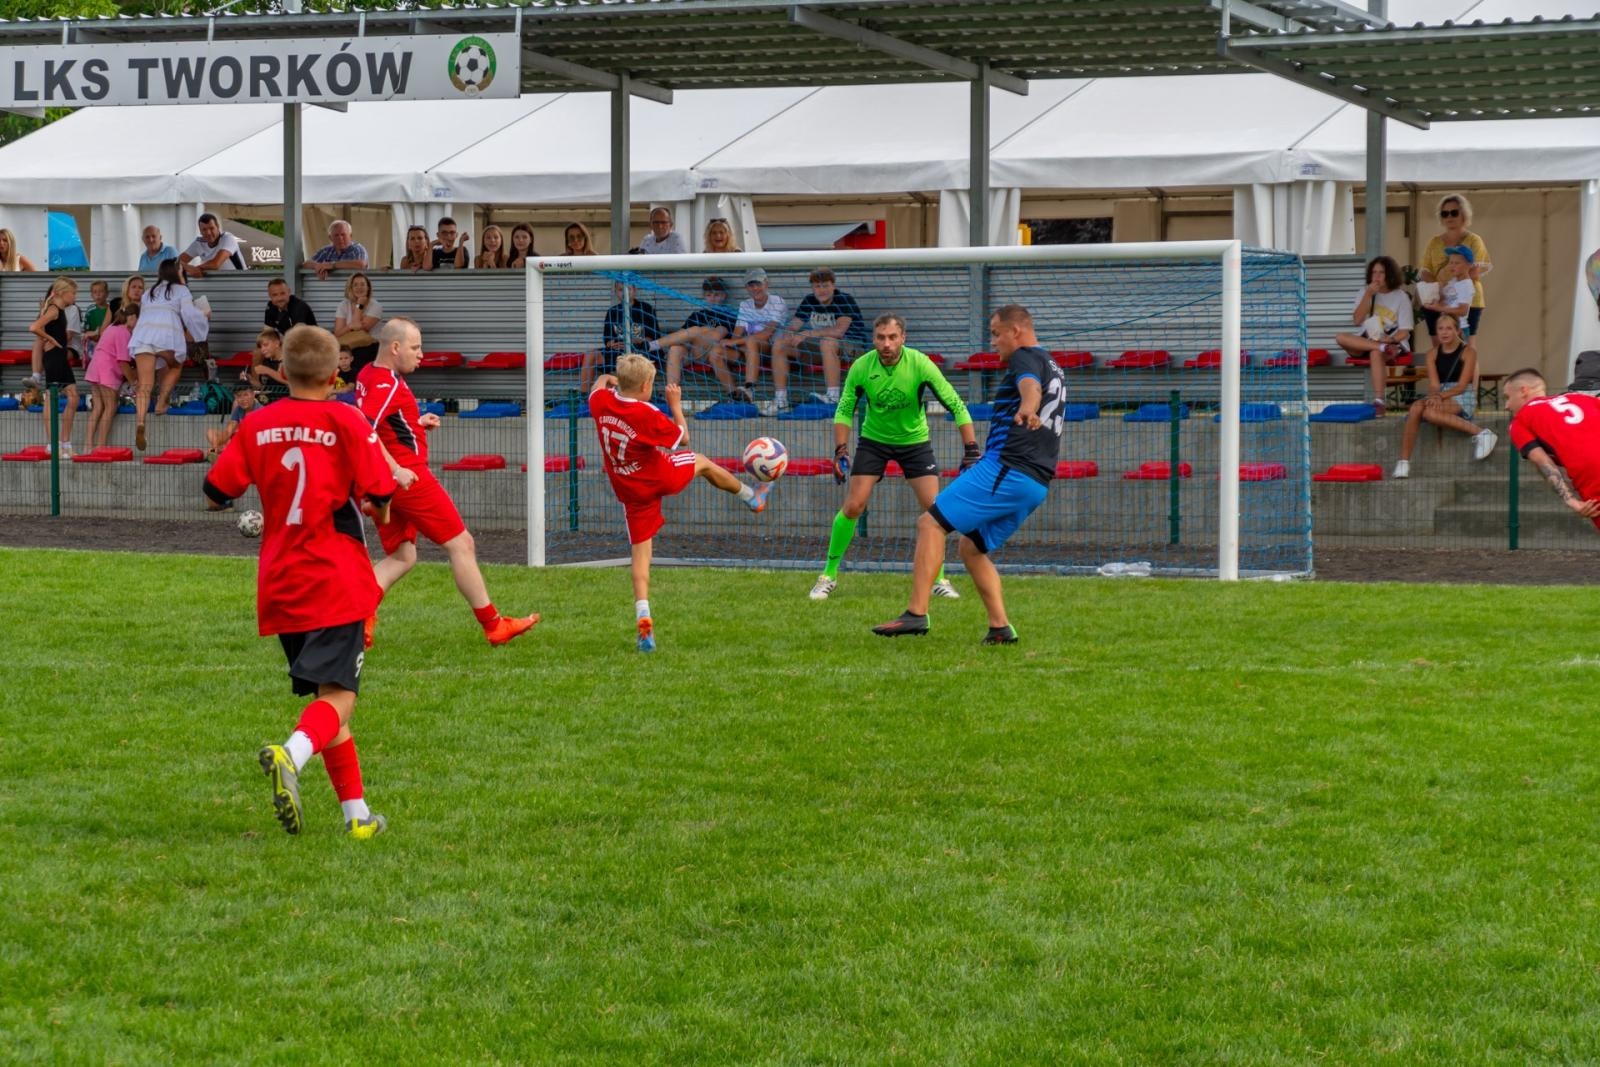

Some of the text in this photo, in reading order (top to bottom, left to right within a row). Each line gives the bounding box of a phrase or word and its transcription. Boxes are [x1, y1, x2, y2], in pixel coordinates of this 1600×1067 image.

[14, 58, 110, 101] LKS
[128, 42, 413, 99] TWORKÓW
[251, 246, 282, 262] Kozel
[1549, 396, 1584, 424] 5
[601, 426, 629, 465] 17
[281, 446, 306, 526] 2
